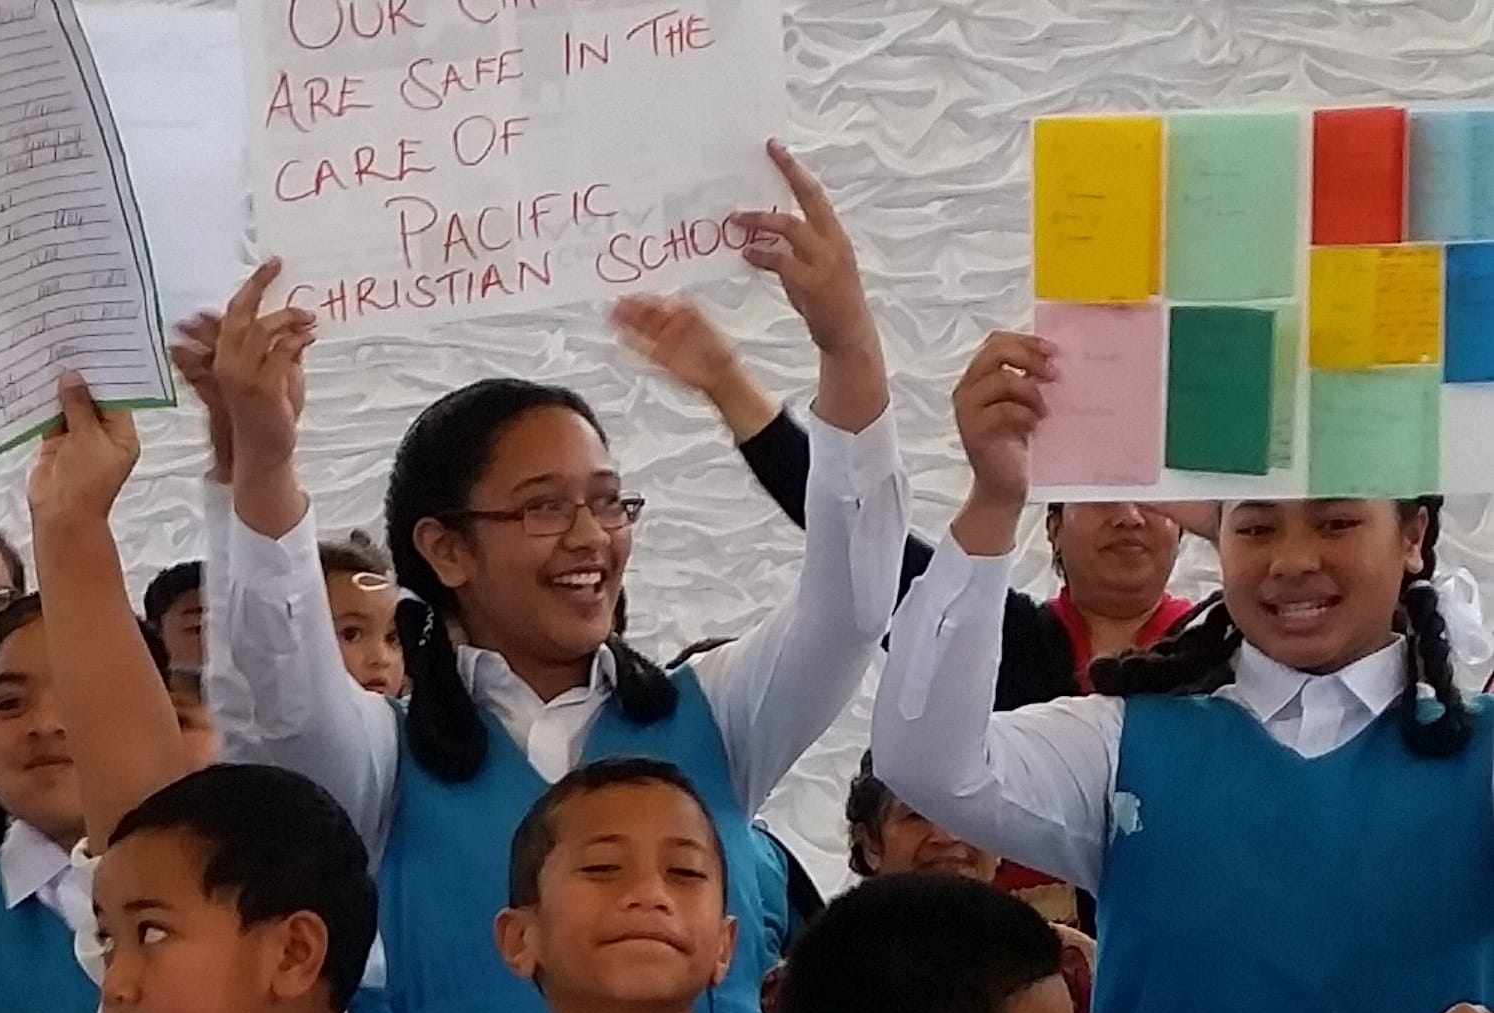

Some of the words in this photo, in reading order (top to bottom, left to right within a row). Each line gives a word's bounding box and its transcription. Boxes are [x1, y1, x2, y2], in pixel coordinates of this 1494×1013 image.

[265, 71, 374, 133] ARE
[399, 47, 525, 110] SAFE
[563, 31, 609, 77] IN
[626, 10, 716, 56] THE
[275, 138, 437, 203] CARE
[452, 115, 532, 167] OF
[384, 183, 619, 270] PACIFIC
[285, 251, 552, 323] CHRISTIAN
